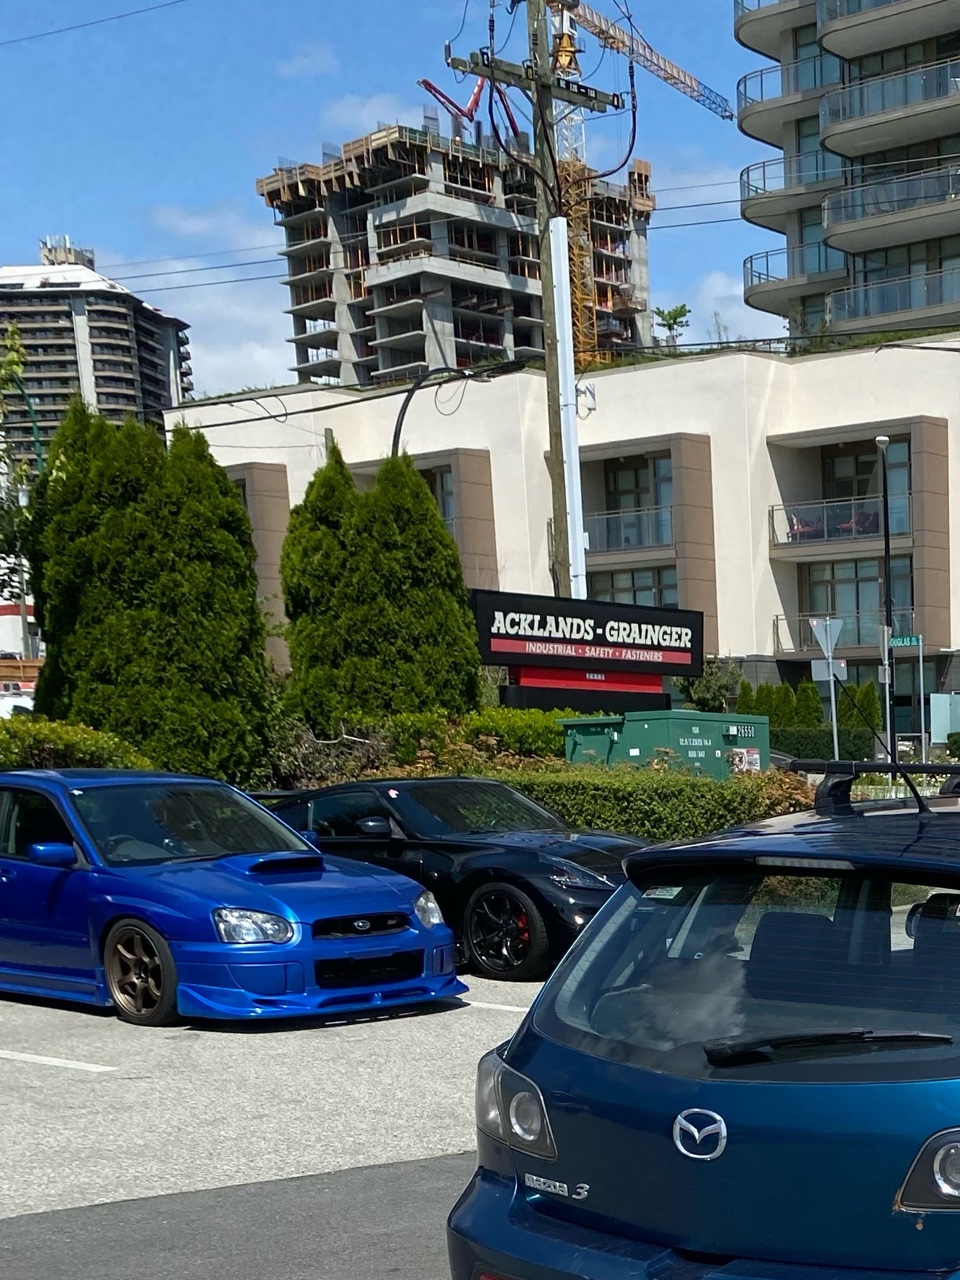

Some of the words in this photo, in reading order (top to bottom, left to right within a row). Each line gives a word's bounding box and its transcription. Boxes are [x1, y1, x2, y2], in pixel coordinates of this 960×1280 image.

[490, 611, 595, 641] ACKLANDS
[605, 621, 692, 648] GRAINGER
[889, 637, 910, 647] OUGLAS
[525, 642, 576, 656] INDUSTRIAL
[585, 646, 614, 658] SAFETY
[621, 649, 663, 661] FASTENERS
[737, 725, 755, 738] 26550
[571, 1182, 590, 1200] 3
